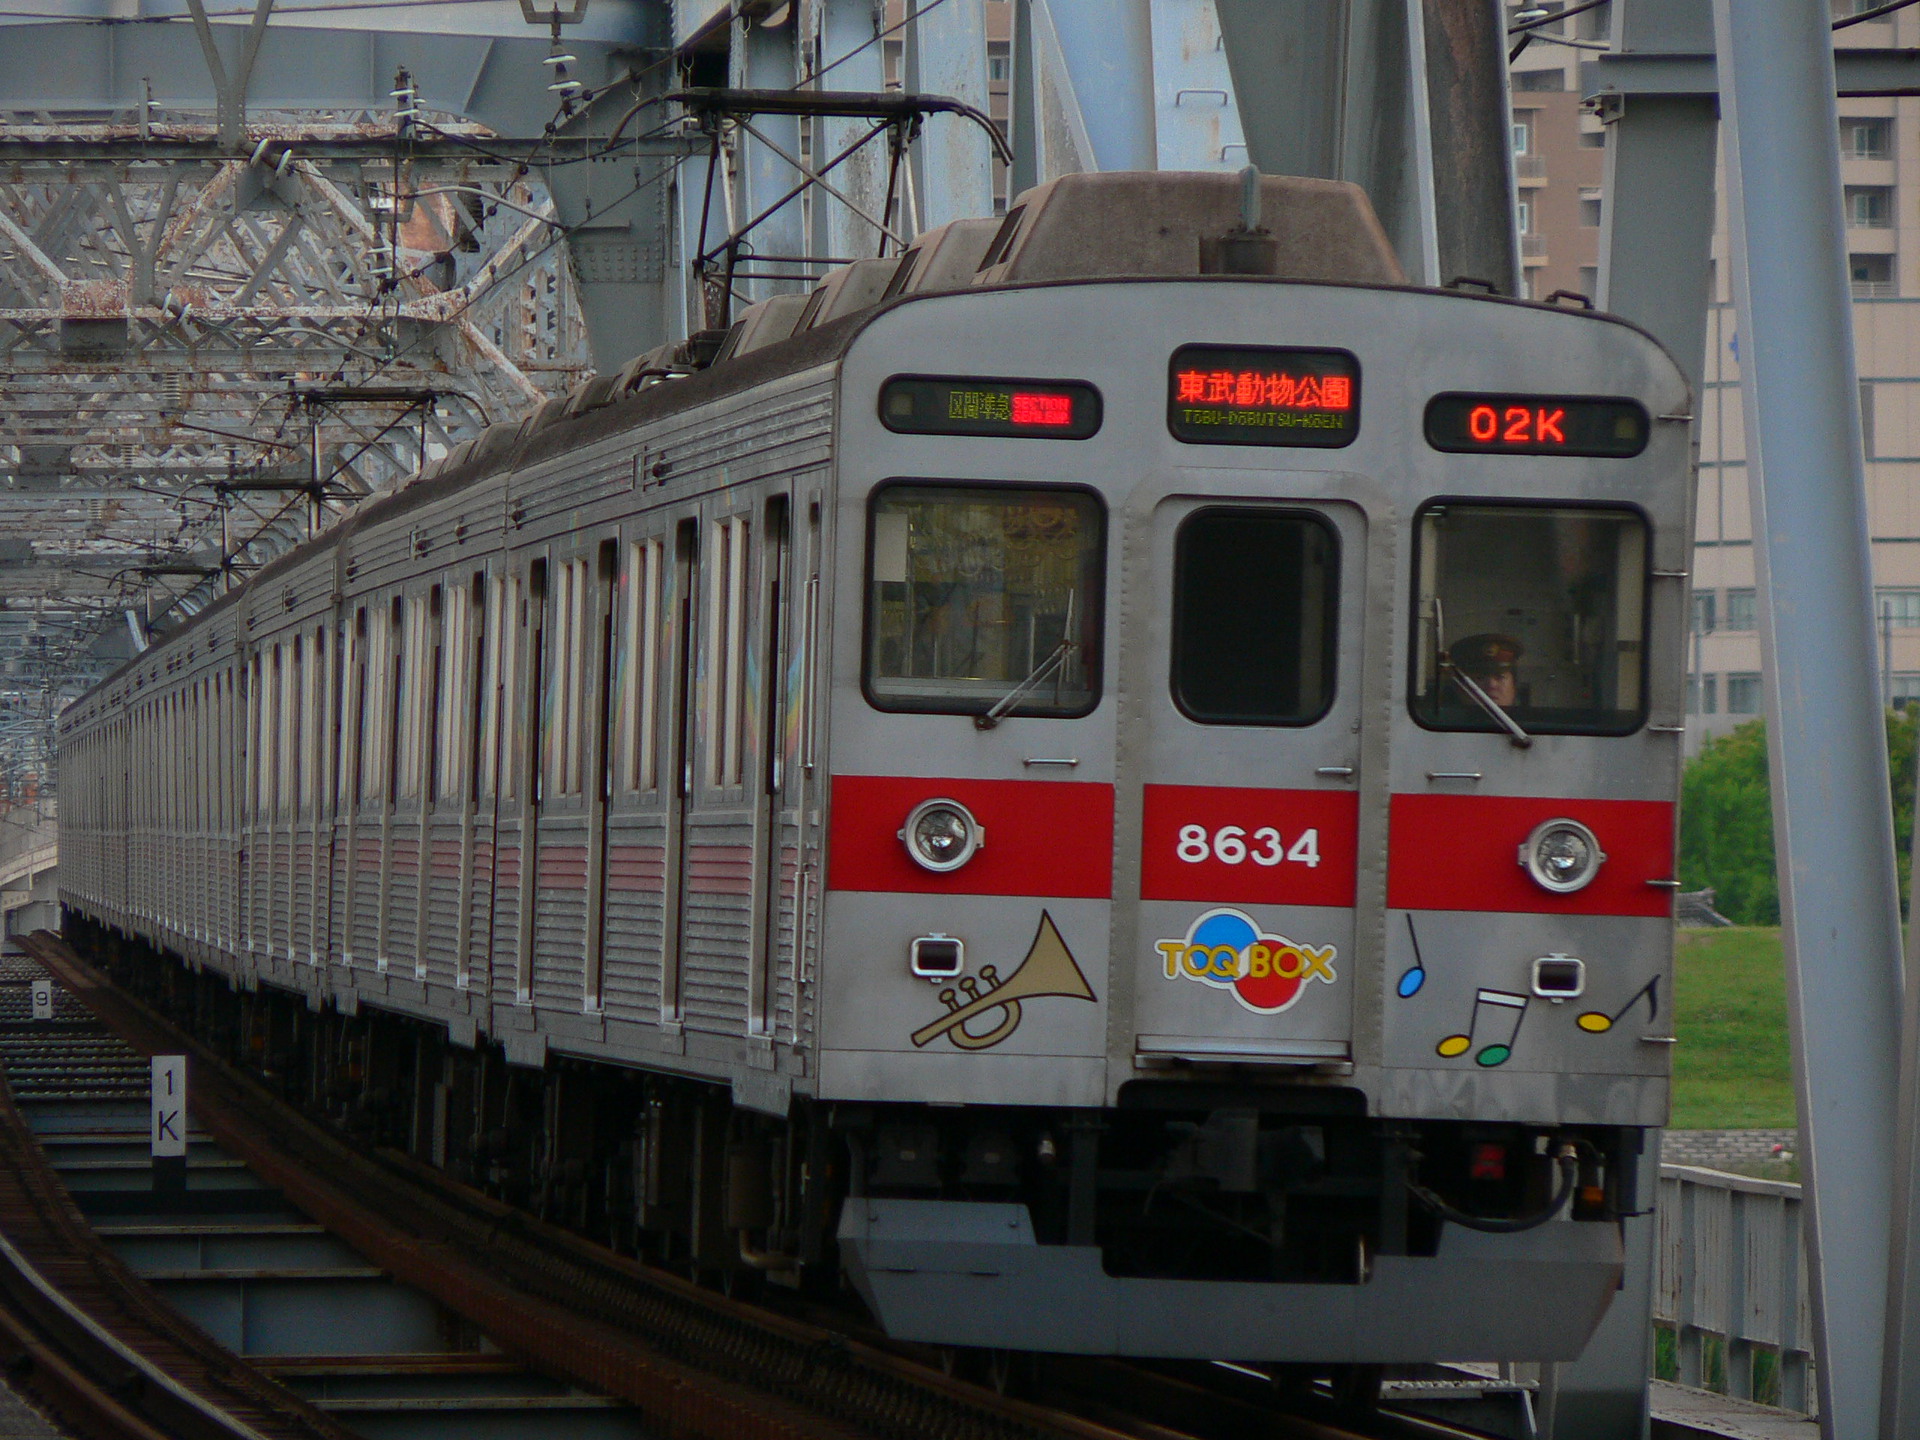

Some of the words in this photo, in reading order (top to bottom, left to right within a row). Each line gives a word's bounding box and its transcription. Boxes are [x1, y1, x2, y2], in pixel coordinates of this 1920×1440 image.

[1176, 370, 1350, 409] 東武動物公園
[1470, 406, 1565, 442] 02K
[1177, 824, 1321, 868] 8634
[1157, 942, 1241, 979] TOQ
[1249, 944, 1335, 980] BOX
[36, 991, 48, 1006] 9
